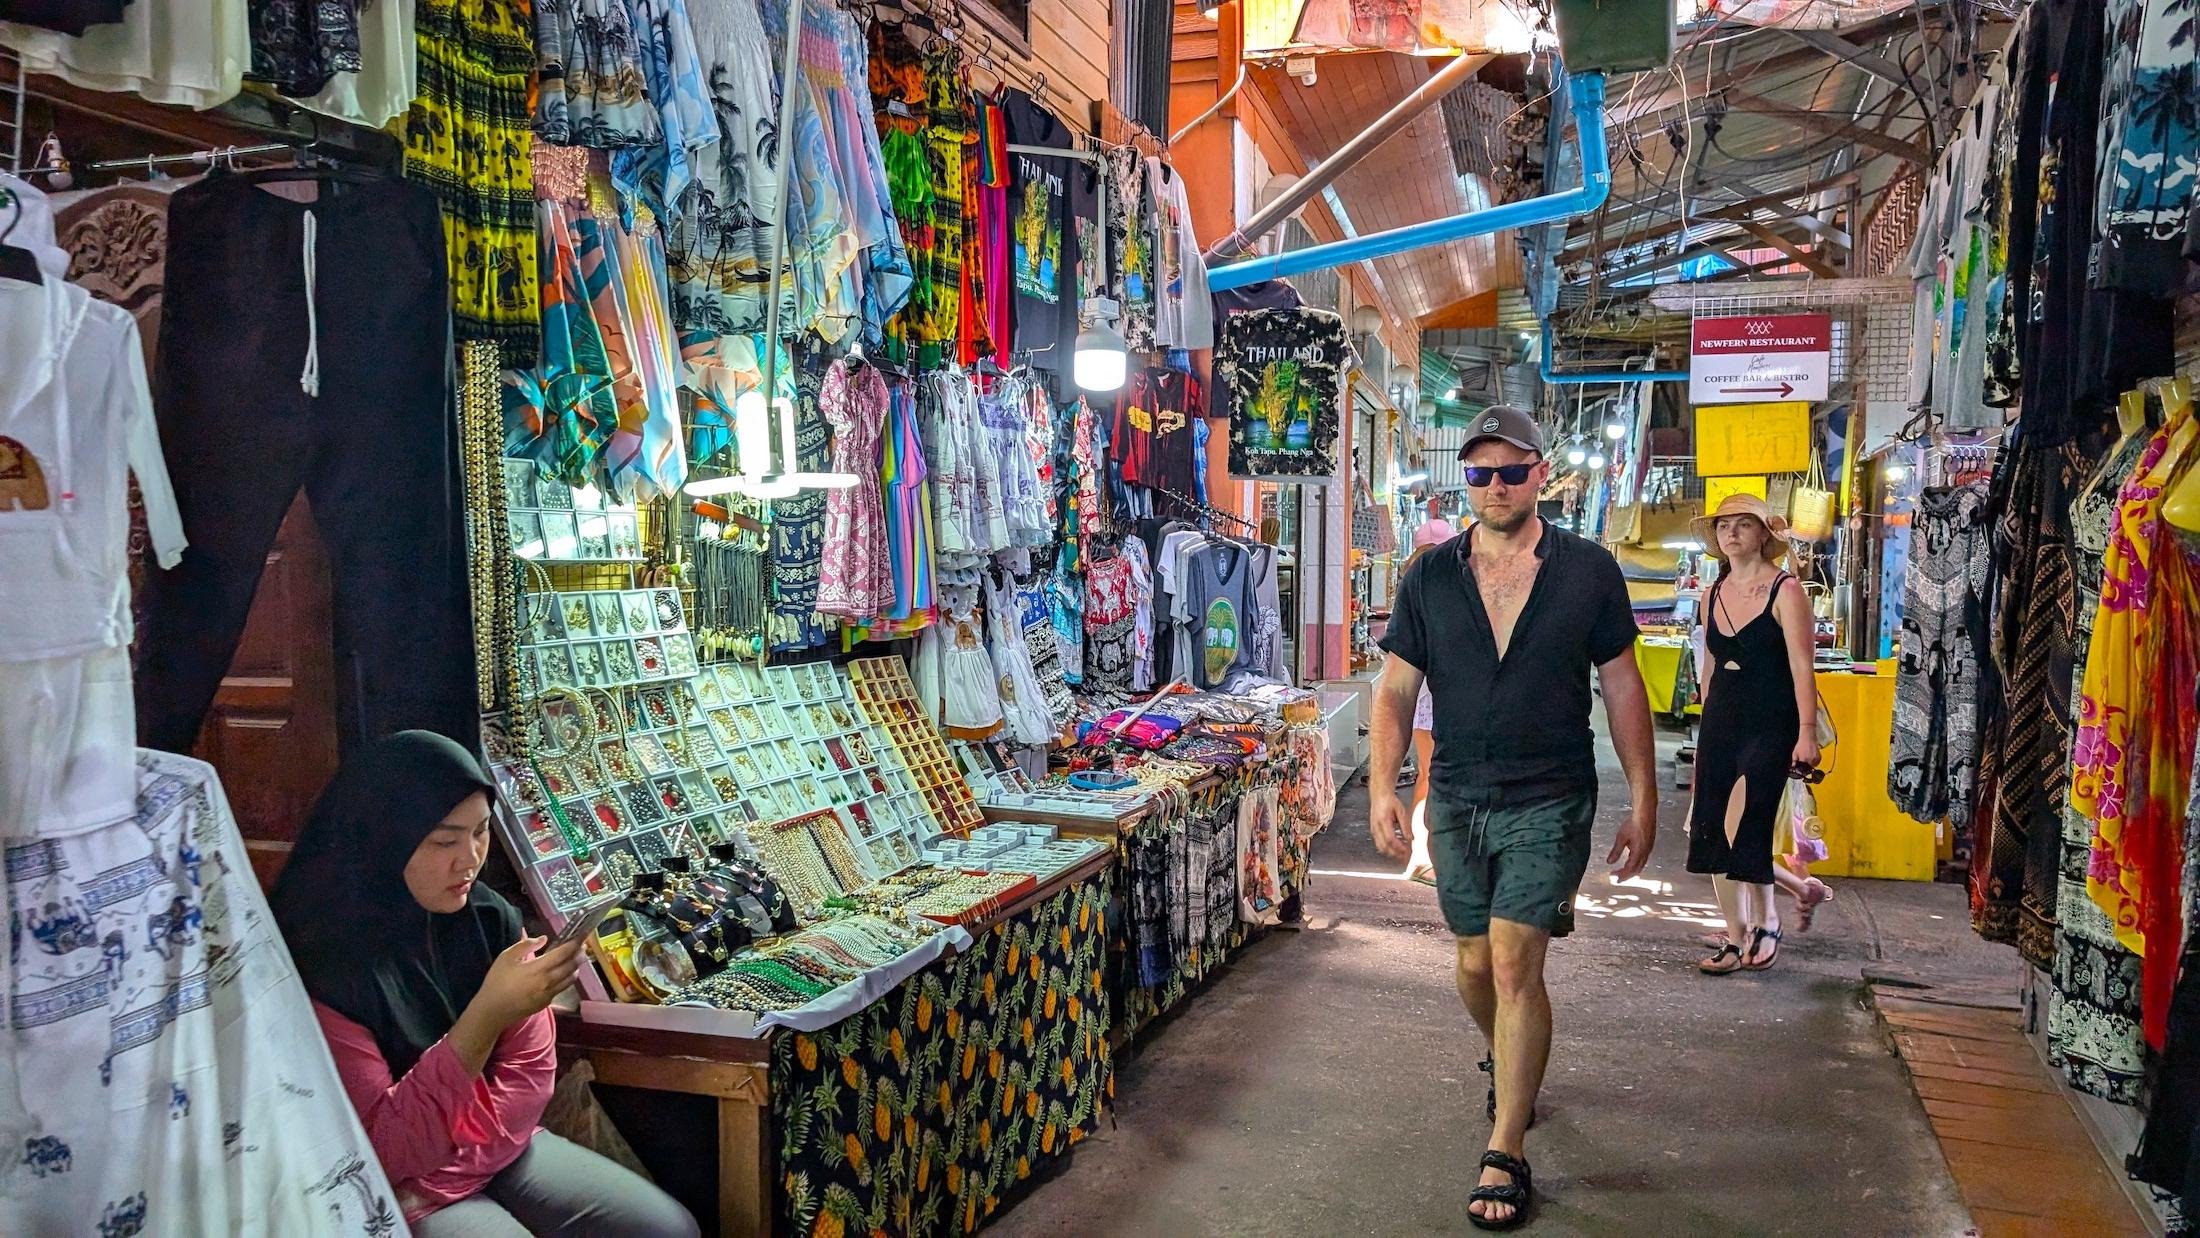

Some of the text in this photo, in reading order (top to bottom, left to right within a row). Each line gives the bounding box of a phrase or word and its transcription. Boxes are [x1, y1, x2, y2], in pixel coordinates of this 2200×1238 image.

[1700, 336, 1816, 348] NEWFERN RESTAURANT
[1246, 346, 1324, 363] THAILAND
[1704, 373, 1809, 383] COFFEE BAR & BISTRO
[1245, 446, 1259, 455] Koh
[1278, 447, 1299, 458] Phang
[1299, 447, 1314, 458] Nga
